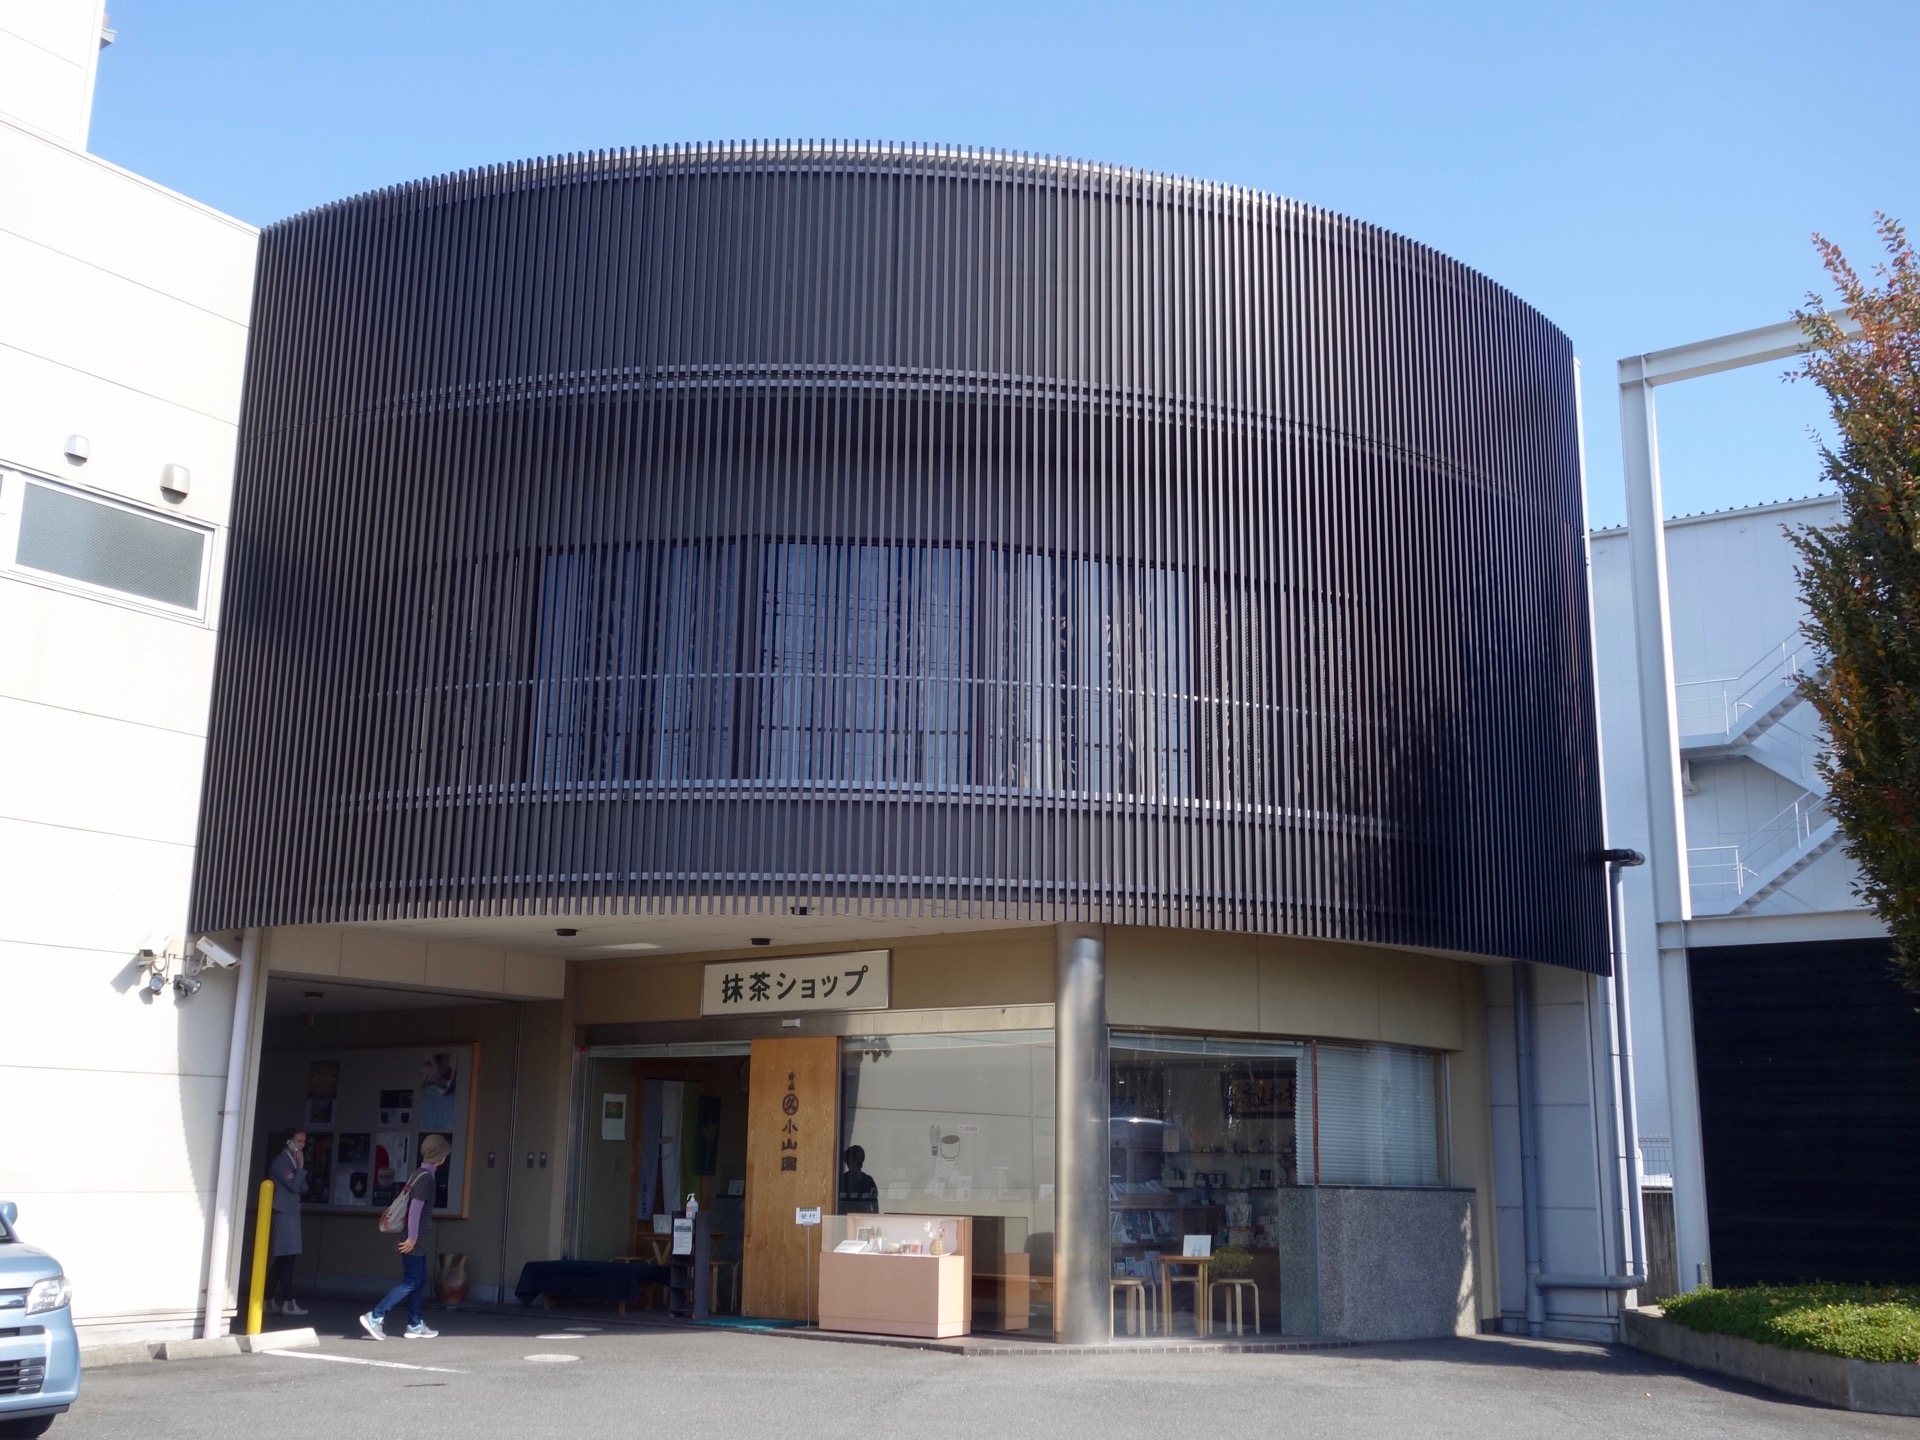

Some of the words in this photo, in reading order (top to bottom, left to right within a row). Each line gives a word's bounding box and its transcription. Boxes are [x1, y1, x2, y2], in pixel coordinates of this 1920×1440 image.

[722, 964, 869, 1004] 抹茶ショップ
